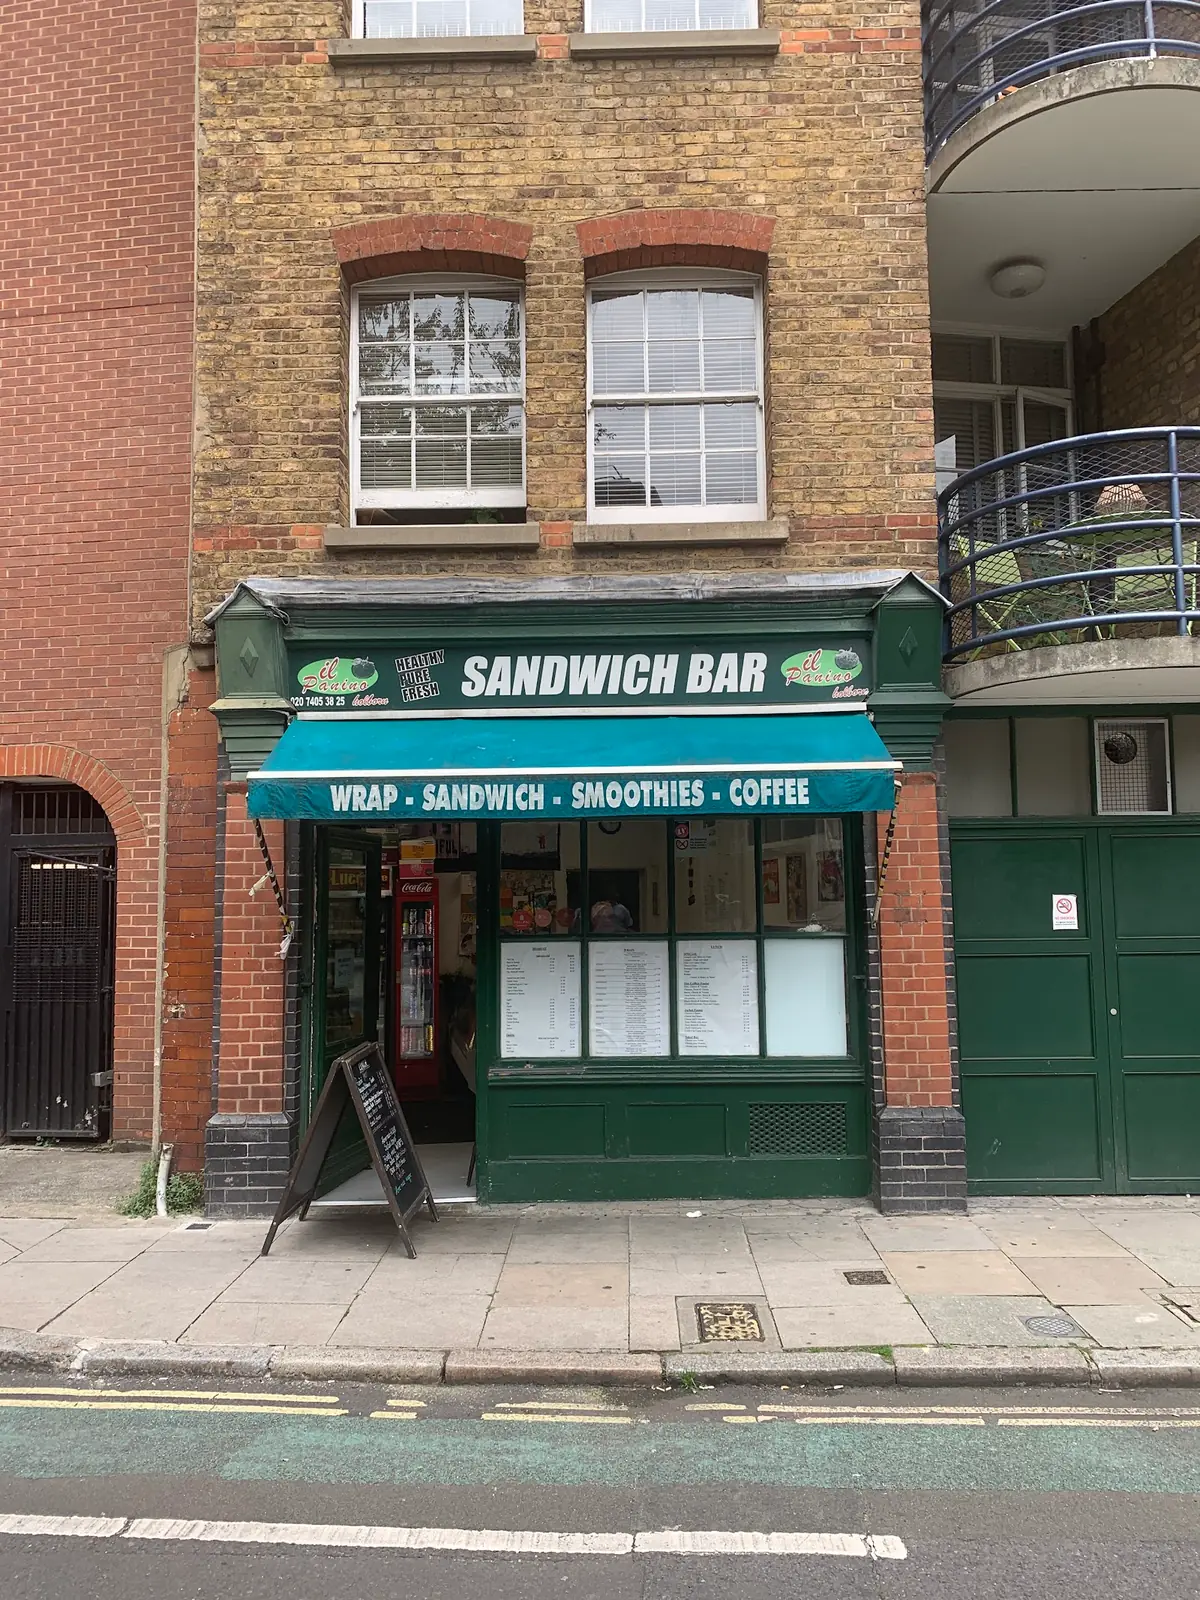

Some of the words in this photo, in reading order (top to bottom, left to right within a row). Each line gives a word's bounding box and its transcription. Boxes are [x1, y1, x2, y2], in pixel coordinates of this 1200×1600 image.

[395, 650, 445, 673] HEALTHY
[400, 669, 430, 687] PURE
[461, 654, 679, 697] SANDWICH
[686, 652, 768, 694] BAR
[786, 667, 852, 686] Panino
[302, 676, 368, 694] Panino
[402, 683, 440, 702] FRESH
[306, 697, 324, 707] 7405
[325, 697, 334, 706] 38
[336, 696, 345, 706] 25
[330, 784, 398, 812] WRAP
[422, 783, 544, 811] SANDWICH
[571, 779, 705, 809] SMOOTHIES
[729, 778, 810, 806] COFFEE
